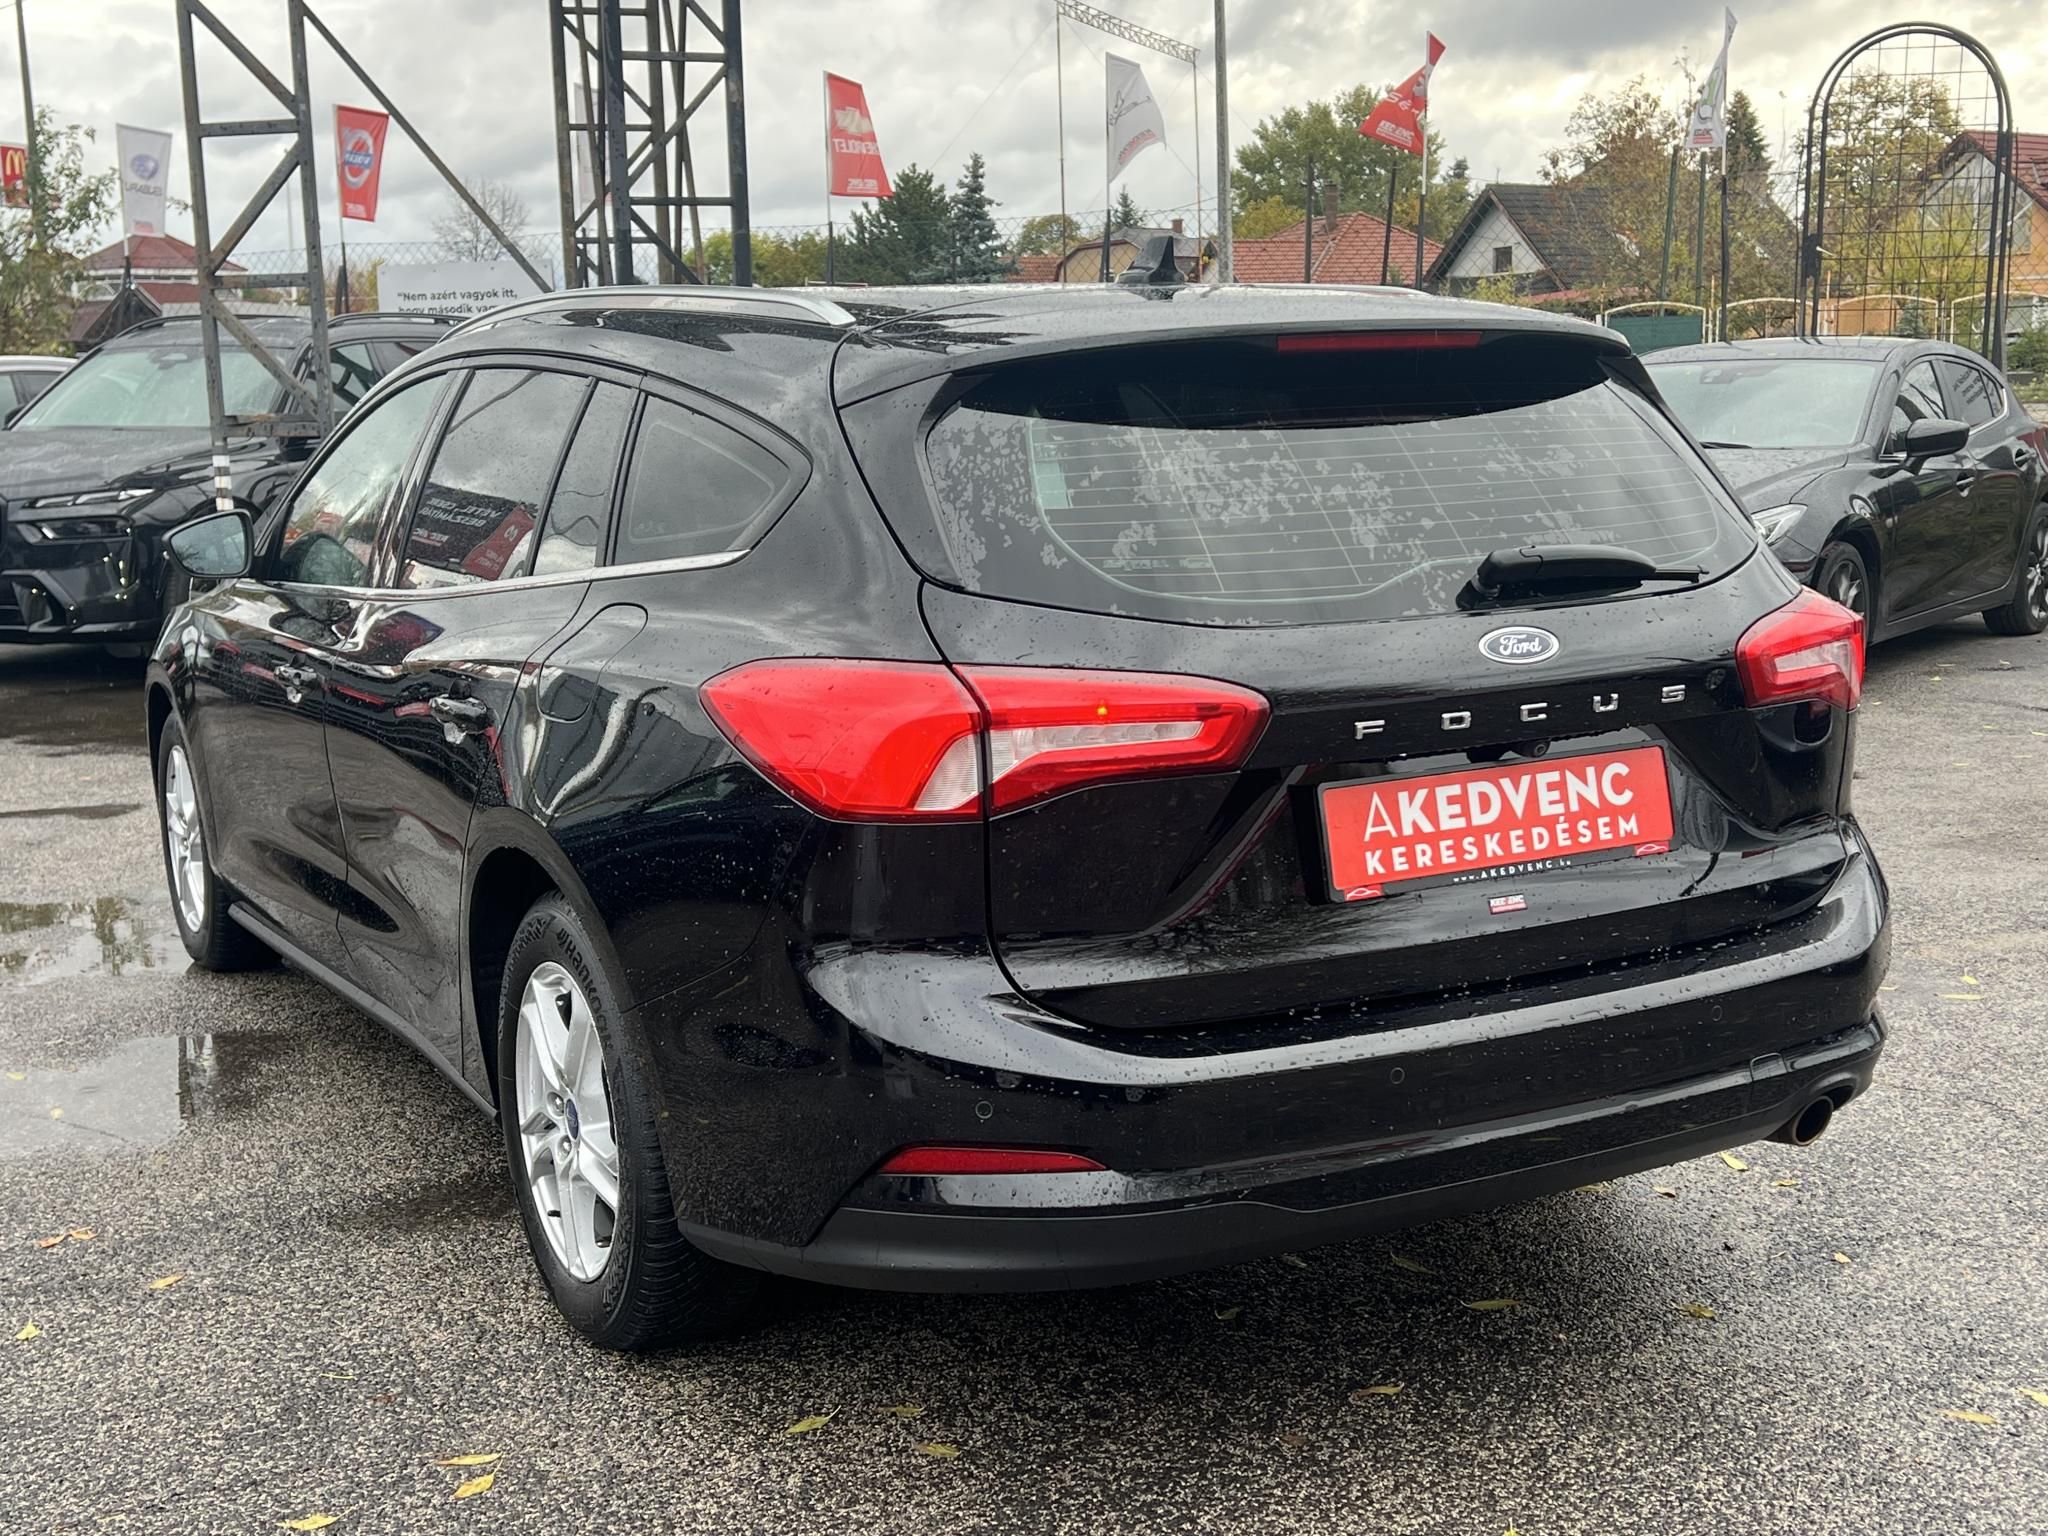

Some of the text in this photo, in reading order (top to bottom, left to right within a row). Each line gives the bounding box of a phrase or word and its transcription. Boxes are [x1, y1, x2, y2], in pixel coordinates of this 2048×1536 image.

[430, 290, 458, 301] azért
[460, 287, 499, 302] vagyok
[428, 303, 473, 315] második
[1499, 633, 1543, 656] Ford
[1354, 684, 1686, 740] FOCUS
[1365, 812, 1639, 876] KERESKEDÉSEM
